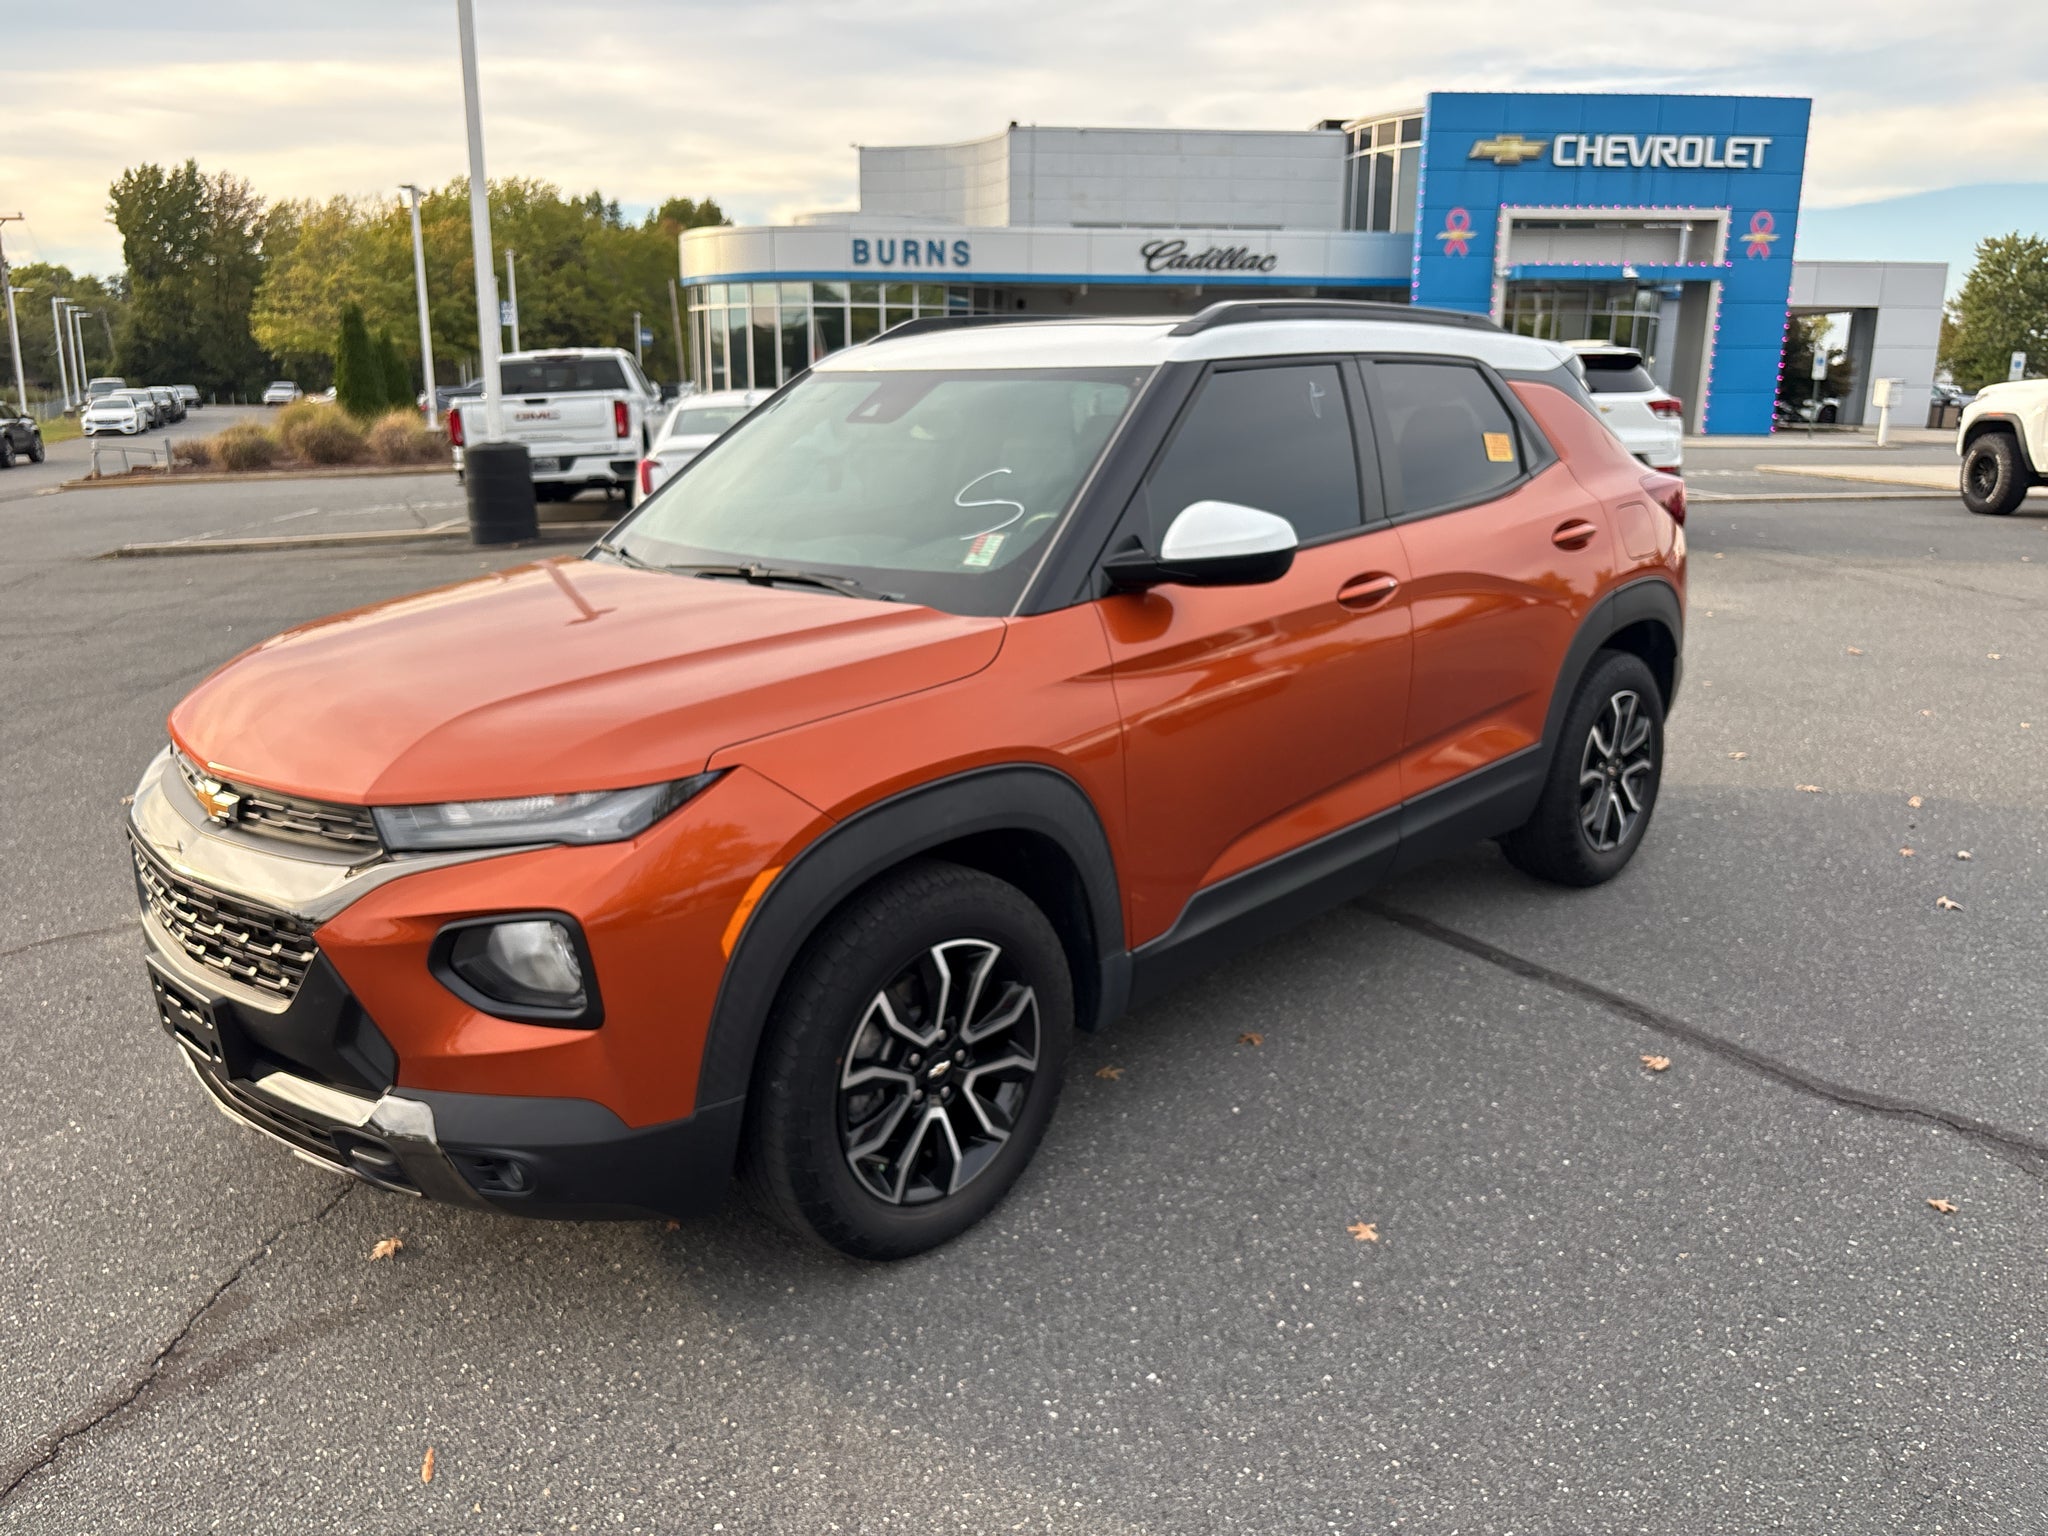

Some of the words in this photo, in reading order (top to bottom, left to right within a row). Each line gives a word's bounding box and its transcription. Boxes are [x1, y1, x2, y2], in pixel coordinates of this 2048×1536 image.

[1552, 134, 1772, 168] CHEVROLET
[852, 239, 971, 267] BURNS
[1140, 239, 1277, 273] Cadillac
